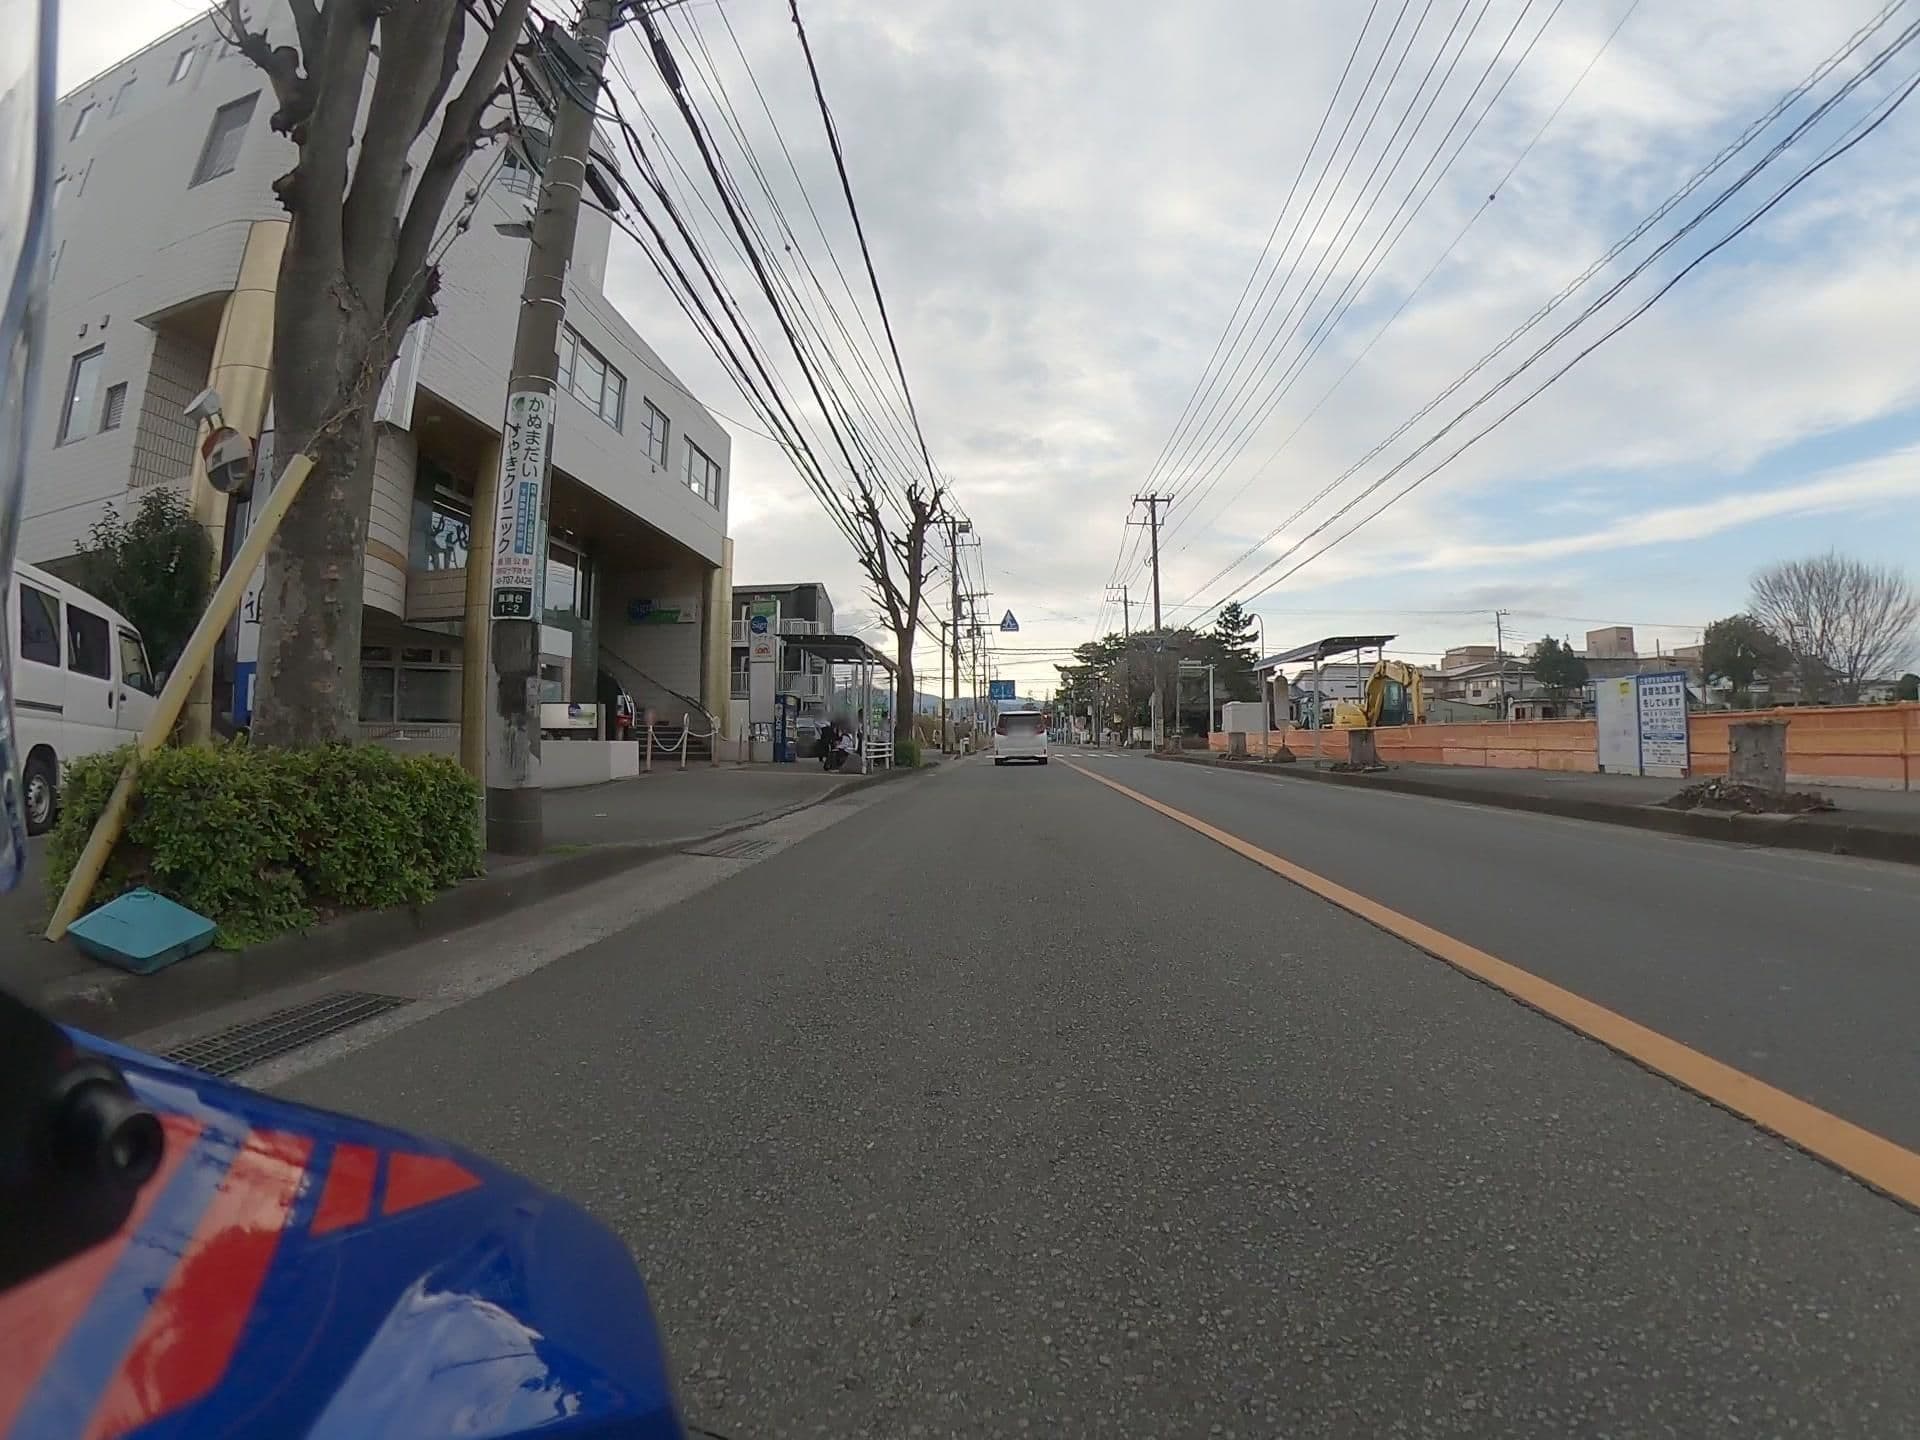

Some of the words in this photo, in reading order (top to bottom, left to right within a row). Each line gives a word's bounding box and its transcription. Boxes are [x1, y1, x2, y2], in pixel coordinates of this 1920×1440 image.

[1643, 698, 1681, 708] をしています
